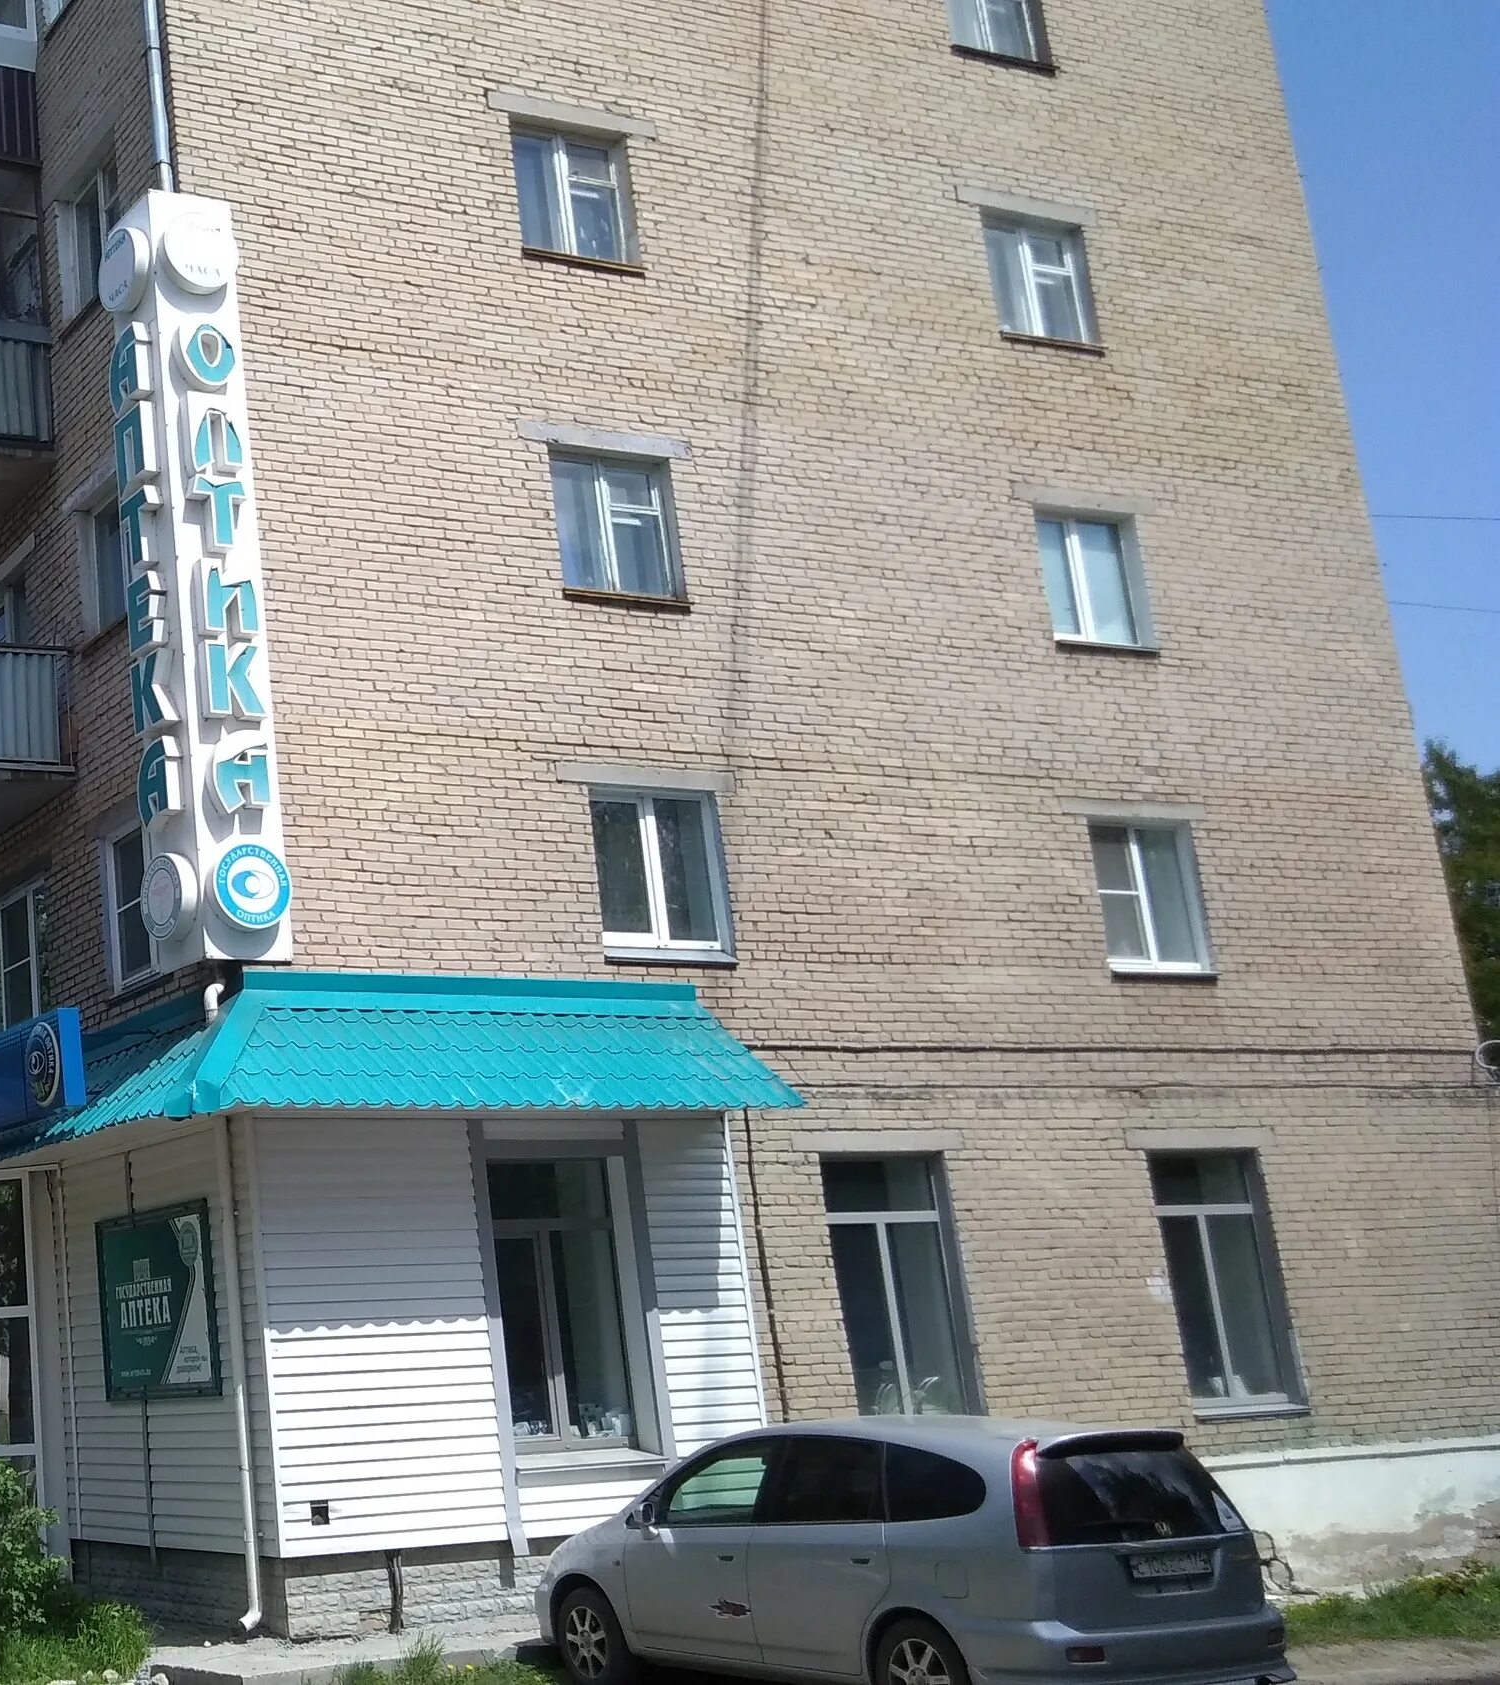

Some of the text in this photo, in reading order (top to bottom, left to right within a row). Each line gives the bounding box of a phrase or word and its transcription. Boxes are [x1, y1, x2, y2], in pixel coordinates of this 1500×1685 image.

[109, 320, 176, 832] АПТЕКА
[184, 322, 271, 815] ОПТИКА
[217, 846, 288, 887] ГОСУДАРСТВЕННАЯ
[236, 909, 276, 923] ОПТИКА
[115, 1278, 173, 1300] ГОСУДАРСТВЕННАЯ
[120, 1295, 172, 1329] АПТЕКА
